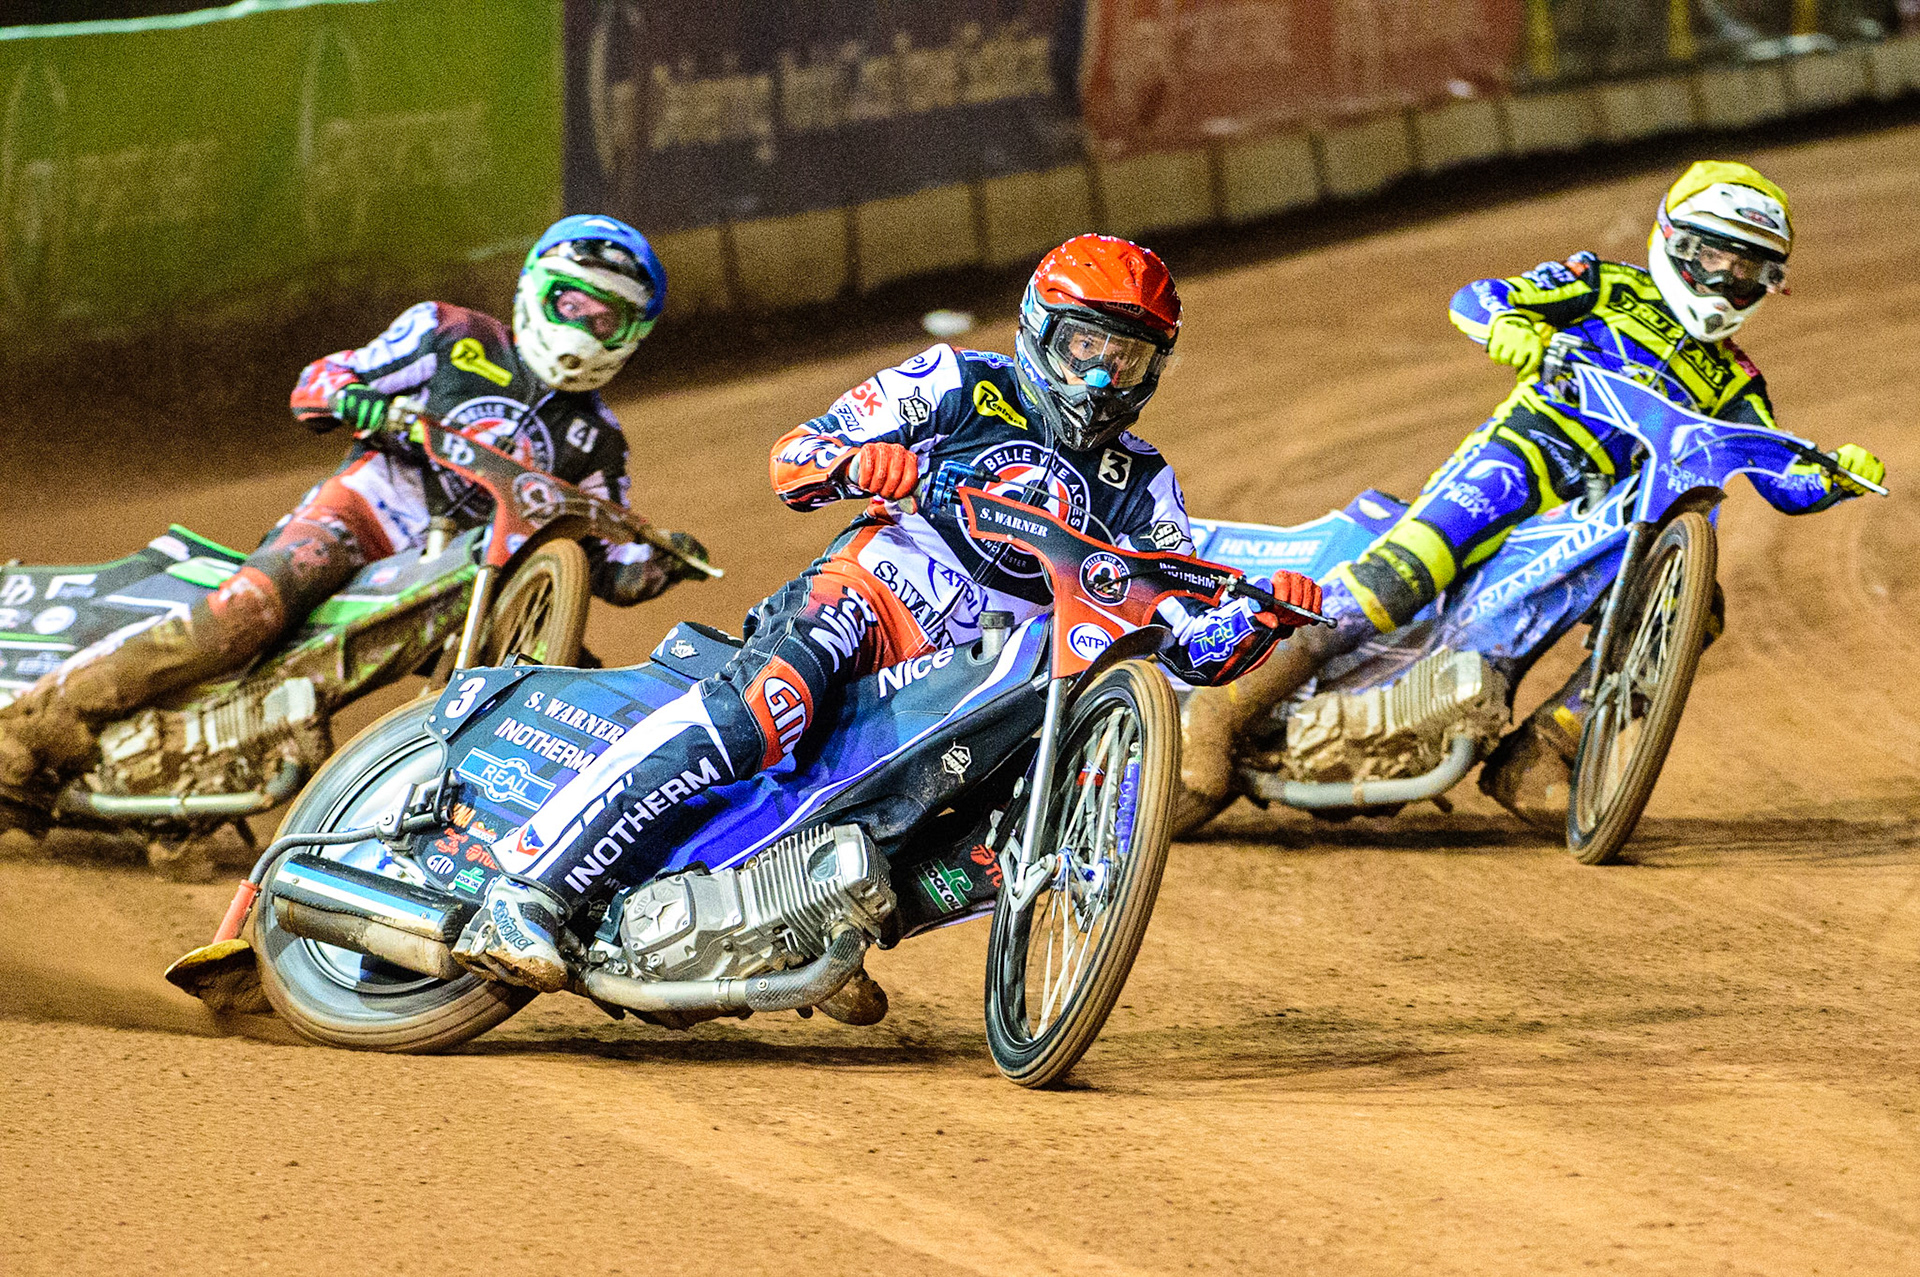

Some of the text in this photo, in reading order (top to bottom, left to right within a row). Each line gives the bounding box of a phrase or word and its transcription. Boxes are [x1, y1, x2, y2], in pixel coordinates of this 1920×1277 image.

[1101, 451, 1129, 484] 3
[1657, 463, 1721, 488] ADRIAN
[983, 448, 1032, 471] BELLE
[1069, 484, 1084, 528] ACES
[979, 508, 1048, 538] S. WARNER
[874, 560, 898, 592] S.
[1085, 554, 1101, 570] BELLE
[1104, 555, 1117, 565] VUE
[1076, 634, 1108, 650] ATPI
[877, 646, 956, 699] Nice
[444, 676, 487, 719] 3
[524, 690, 626, 745] S. WARNER
[494, 716, 597, 774] INOTHERM
[481, 762, 532, 797] REALL
[563, 756, 722, 894] INOTHERM
[491, 899, 536, 952] daytona
